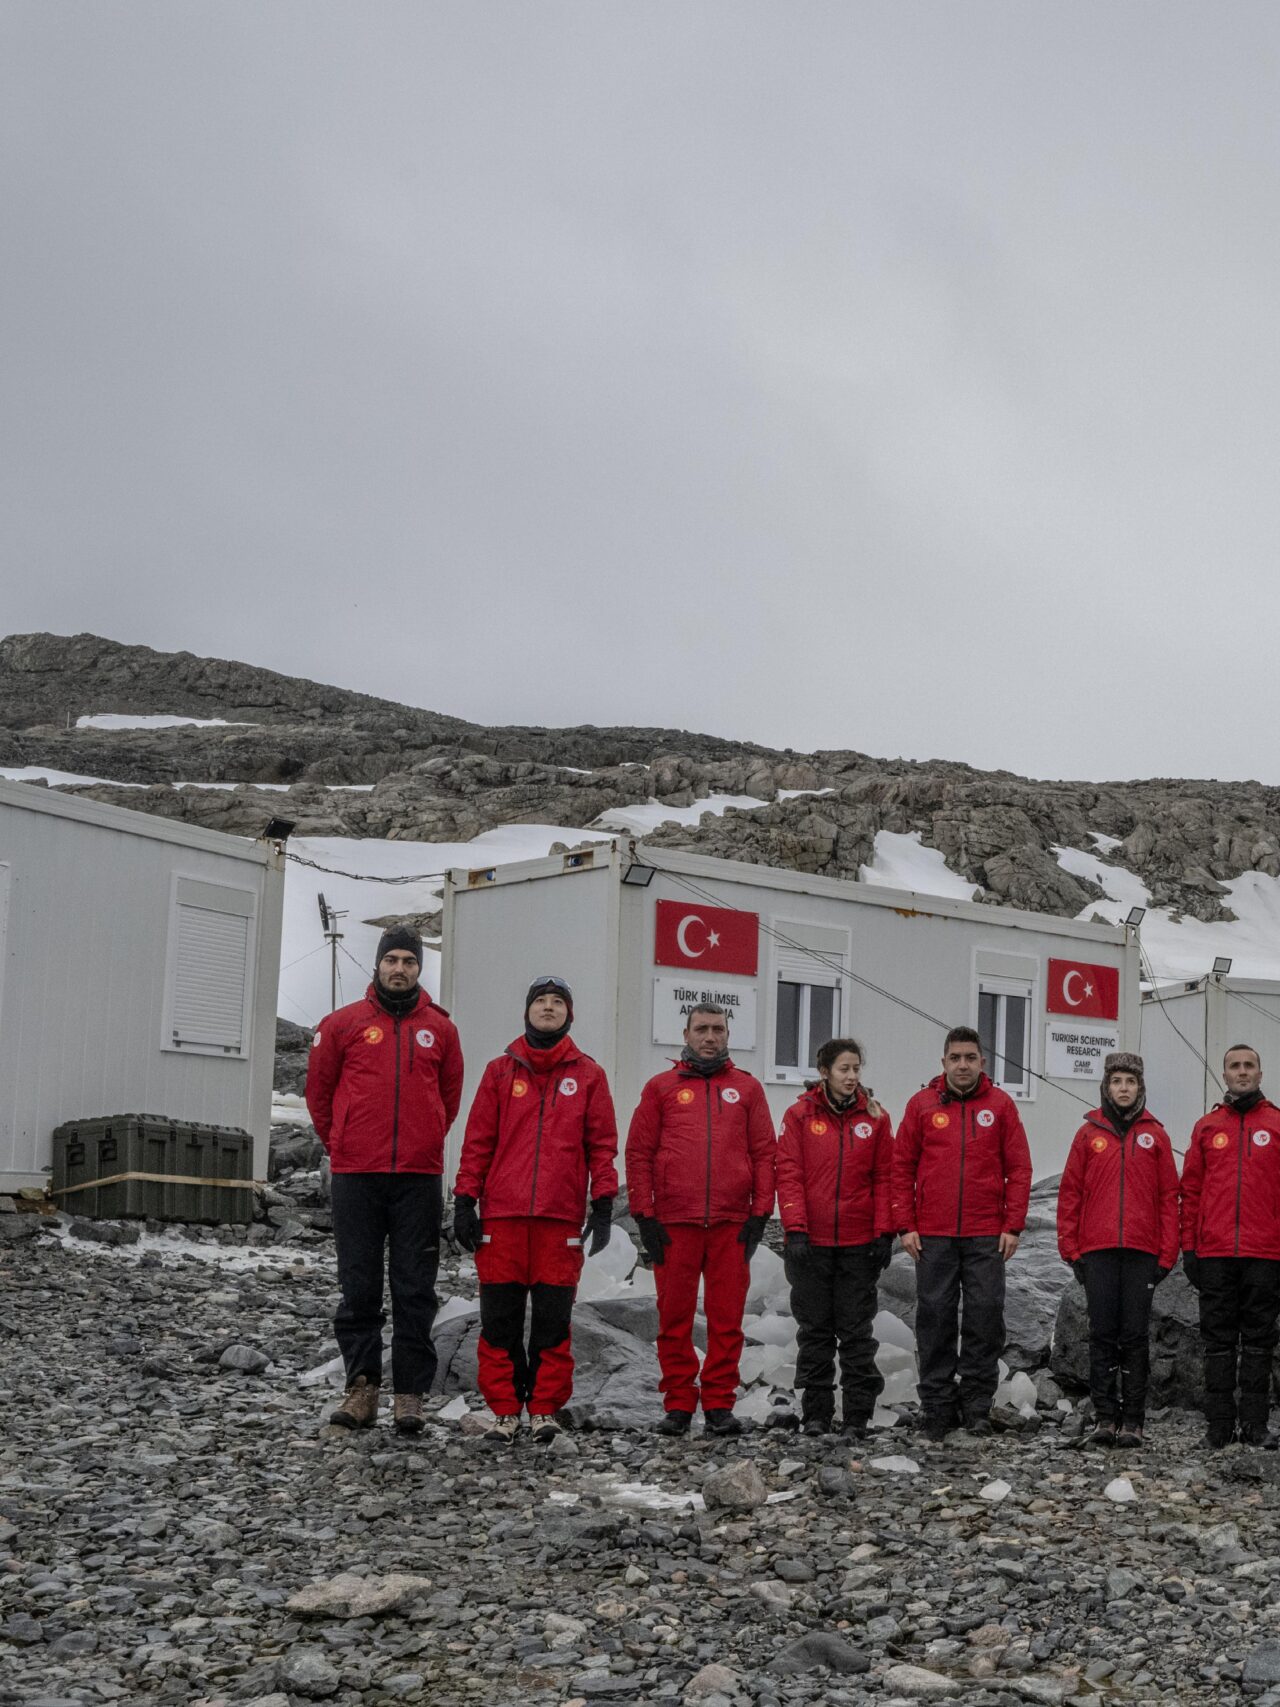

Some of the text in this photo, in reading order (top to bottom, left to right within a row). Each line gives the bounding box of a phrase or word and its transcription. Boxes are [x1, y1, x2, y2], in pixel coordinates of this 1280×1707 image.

[673, 987, 741, 1006] TÜRK BİLİMSEL
[1051, 1032, 1116, 1048] TURKISH SCIENTIFIC
[1066, 1045, 1101, 1057] RESEARCH
[1074, 1060, 1091, 1068] CAMP
